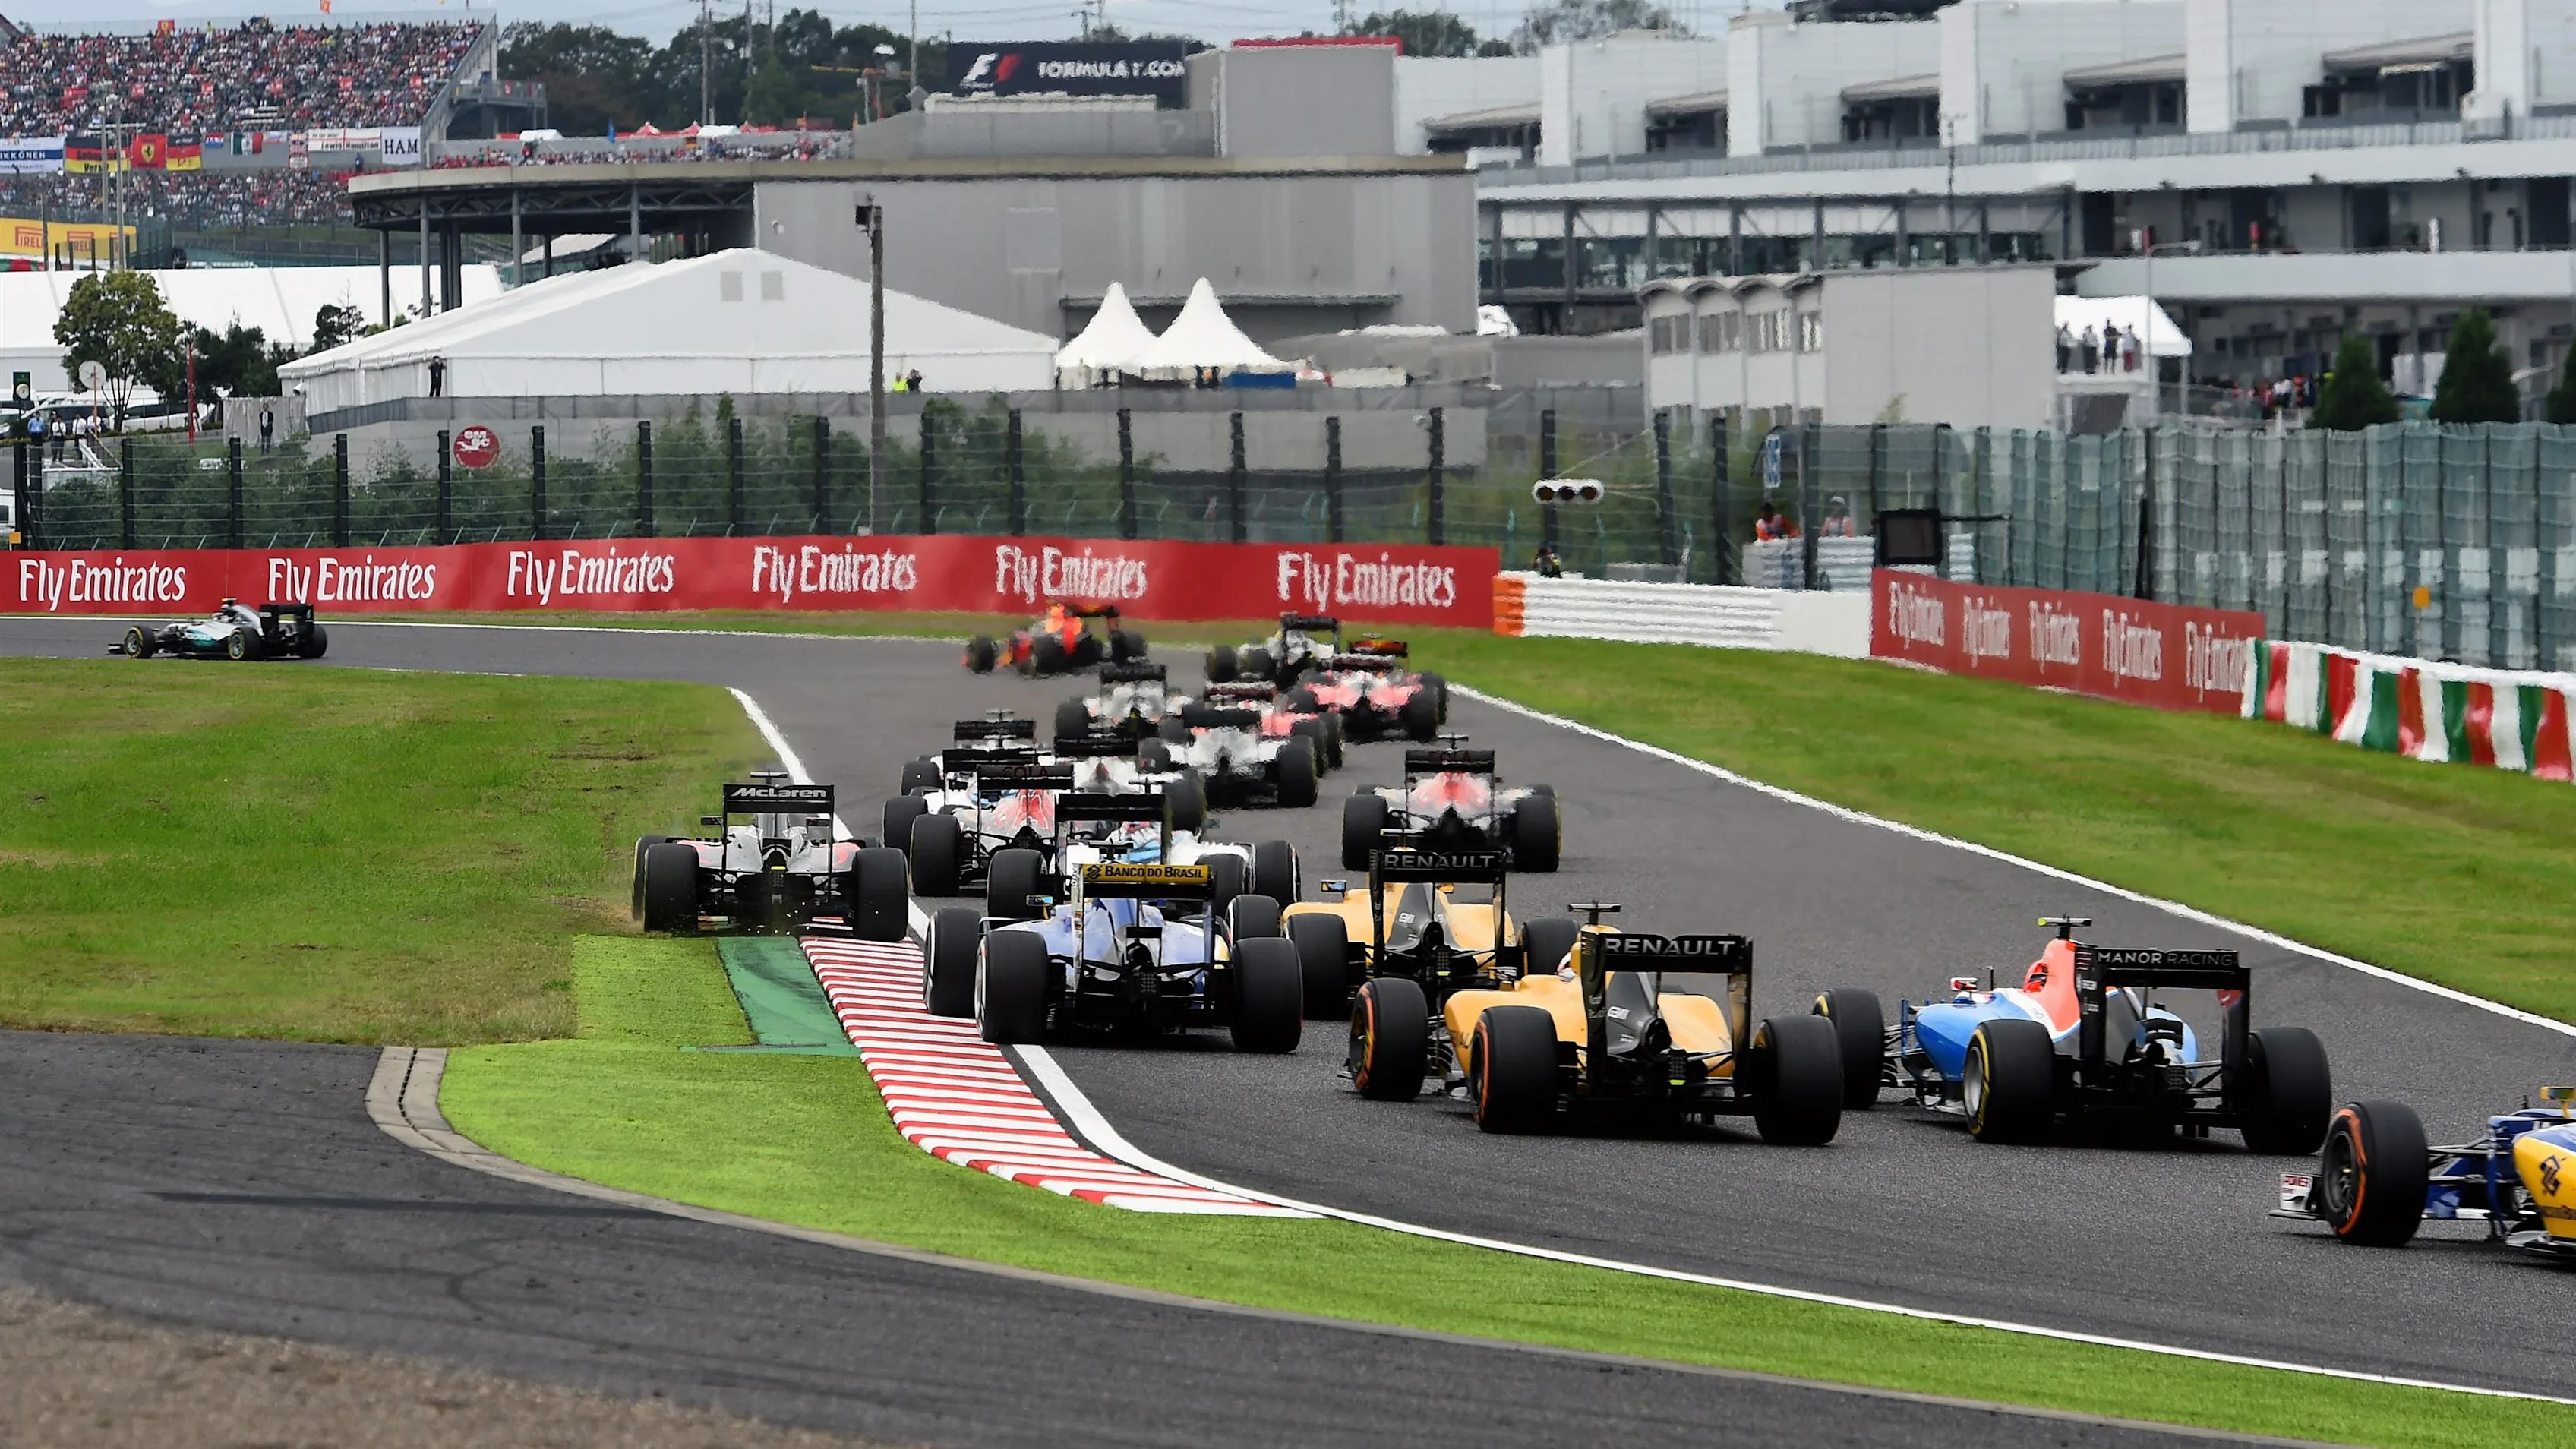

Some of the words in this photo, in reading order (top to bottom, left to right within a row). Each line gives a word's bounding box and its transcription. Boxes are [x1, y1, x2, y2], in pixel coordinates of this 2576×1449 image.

[384, 139, 418, 154] HAM
[19, 558, 65, 611] Fly
[69, 557, 186, 602] Emirates
[267, 557, 311, 604] Fly
[317, 554, 436, 601] Emirates
[507, 550, 555, 605] Fly
[560, 546, 674, 595] Emirates
[752, 545, 797, 604] Fly
[800, 542, 917, 592] Emirates
[996, 544, 1037, 605] Fly
[1041, 545, 1148, 598] Emirates
[1277, 551, 1330, 614] Fly
[1335, 551, 1456, 607] Emirates
[731, 787, 827, 797] McLaren
[1105, 865, 1145, 878] BANCO
[1148, 867, 1161, 878] DO
[1164, 867, 1204, 879] BRASIL
[1384, 854, 1495, 868] RENAULT
[1605, 938, 1736, 955] RENAULT
[2096, 952, 2162, 964] MANOR
[2167, 952, 2233, 966] RACING
